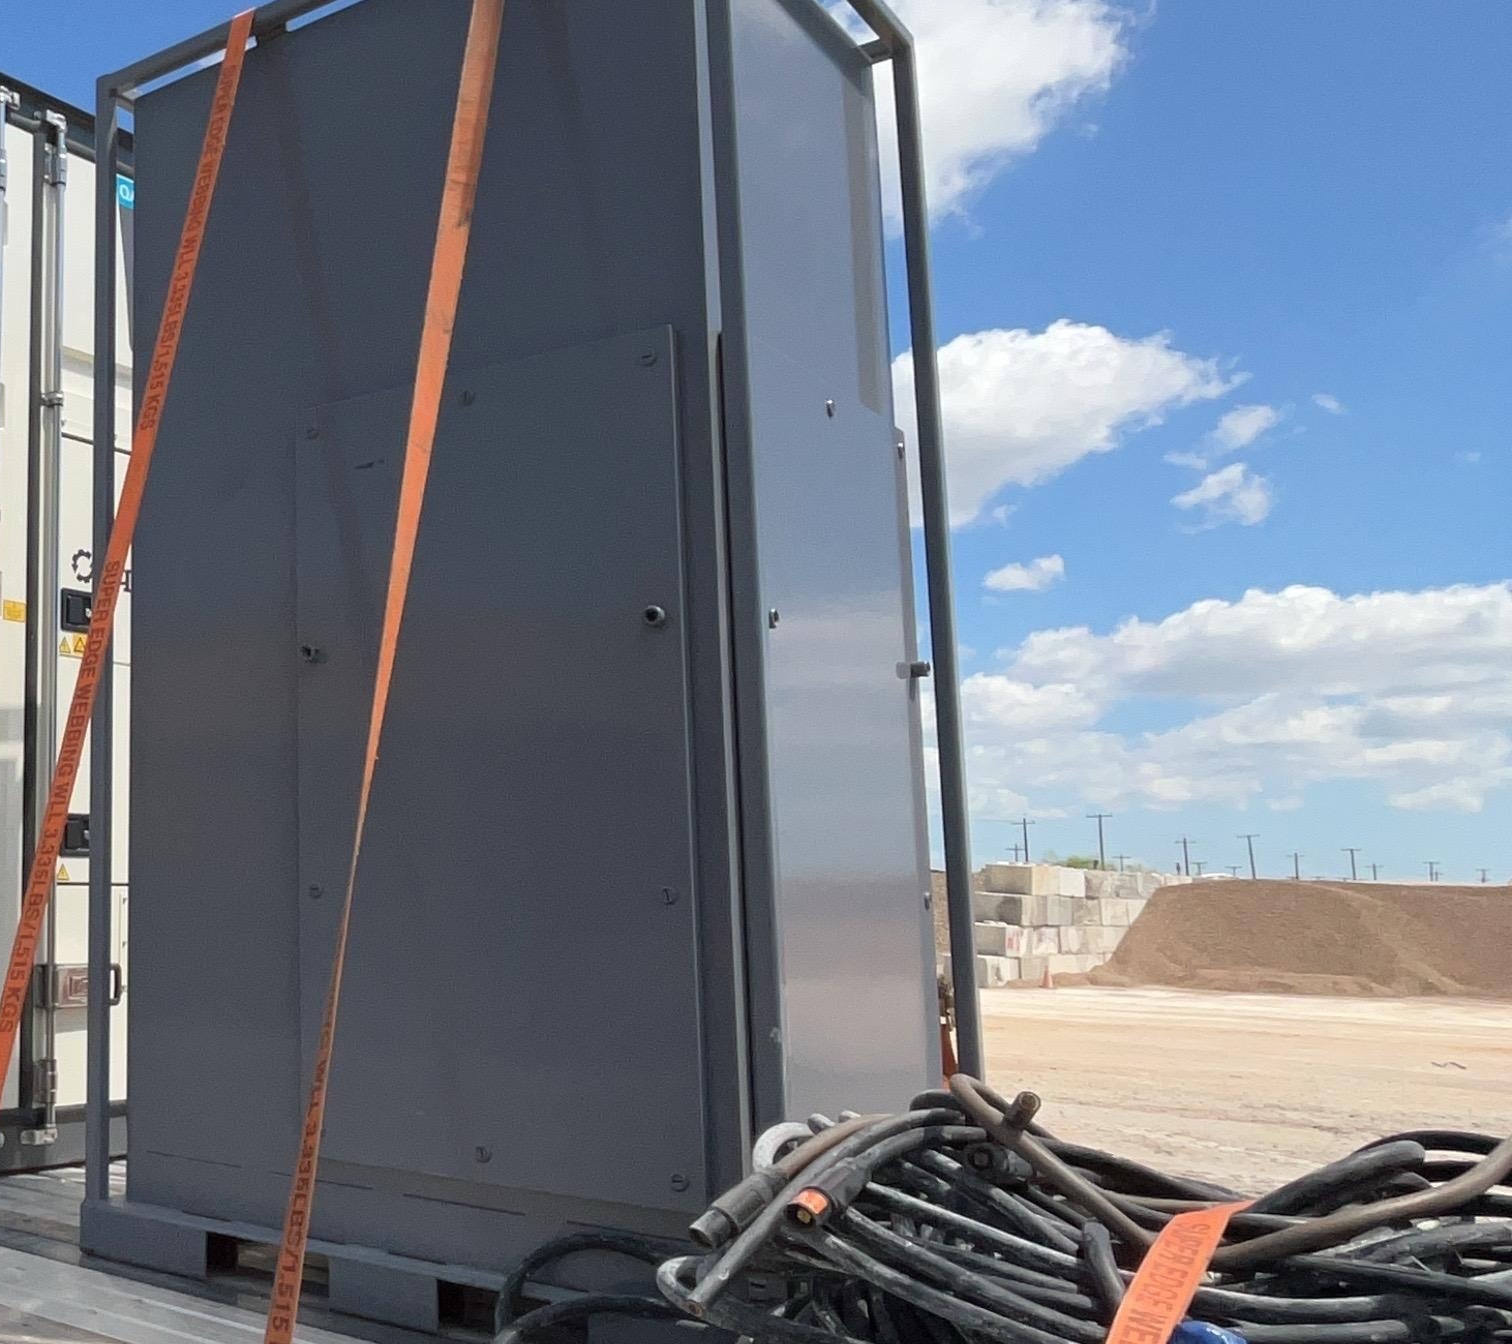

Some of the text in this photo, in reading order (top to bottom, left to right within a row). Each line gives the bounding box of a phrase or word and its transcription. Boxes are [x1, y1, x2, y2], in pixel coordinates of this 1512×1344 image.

[139, 392, 163, 431] KGS
[89, 559, 121, 623] SUPER
[78, 626, 106, 680] EDGE
[56, 681, 94, 777] WEBBING
[45, 779, 71, 827] WLL
[1158, 1220, 1212, 1261] SUPER
[1135, 1262, 1190, 1313] EDGE
